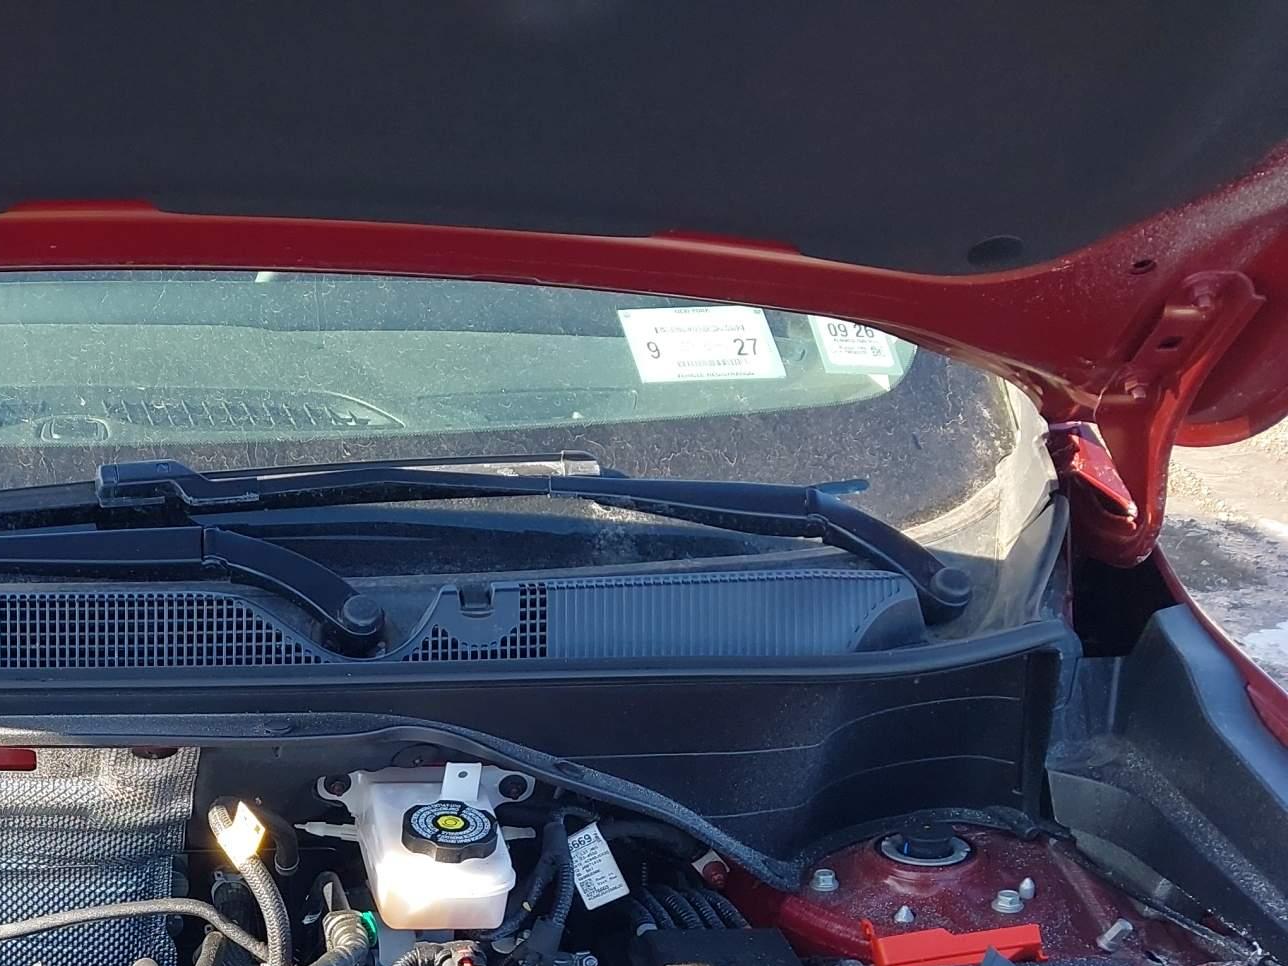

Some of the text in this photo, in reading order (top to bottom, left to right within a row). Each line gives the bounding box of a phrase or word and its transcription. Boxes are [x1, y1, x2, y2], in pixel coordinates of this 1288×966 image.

[827, 322, 875, 338] 09 26
[646, 338, 758, 359] 9 27
